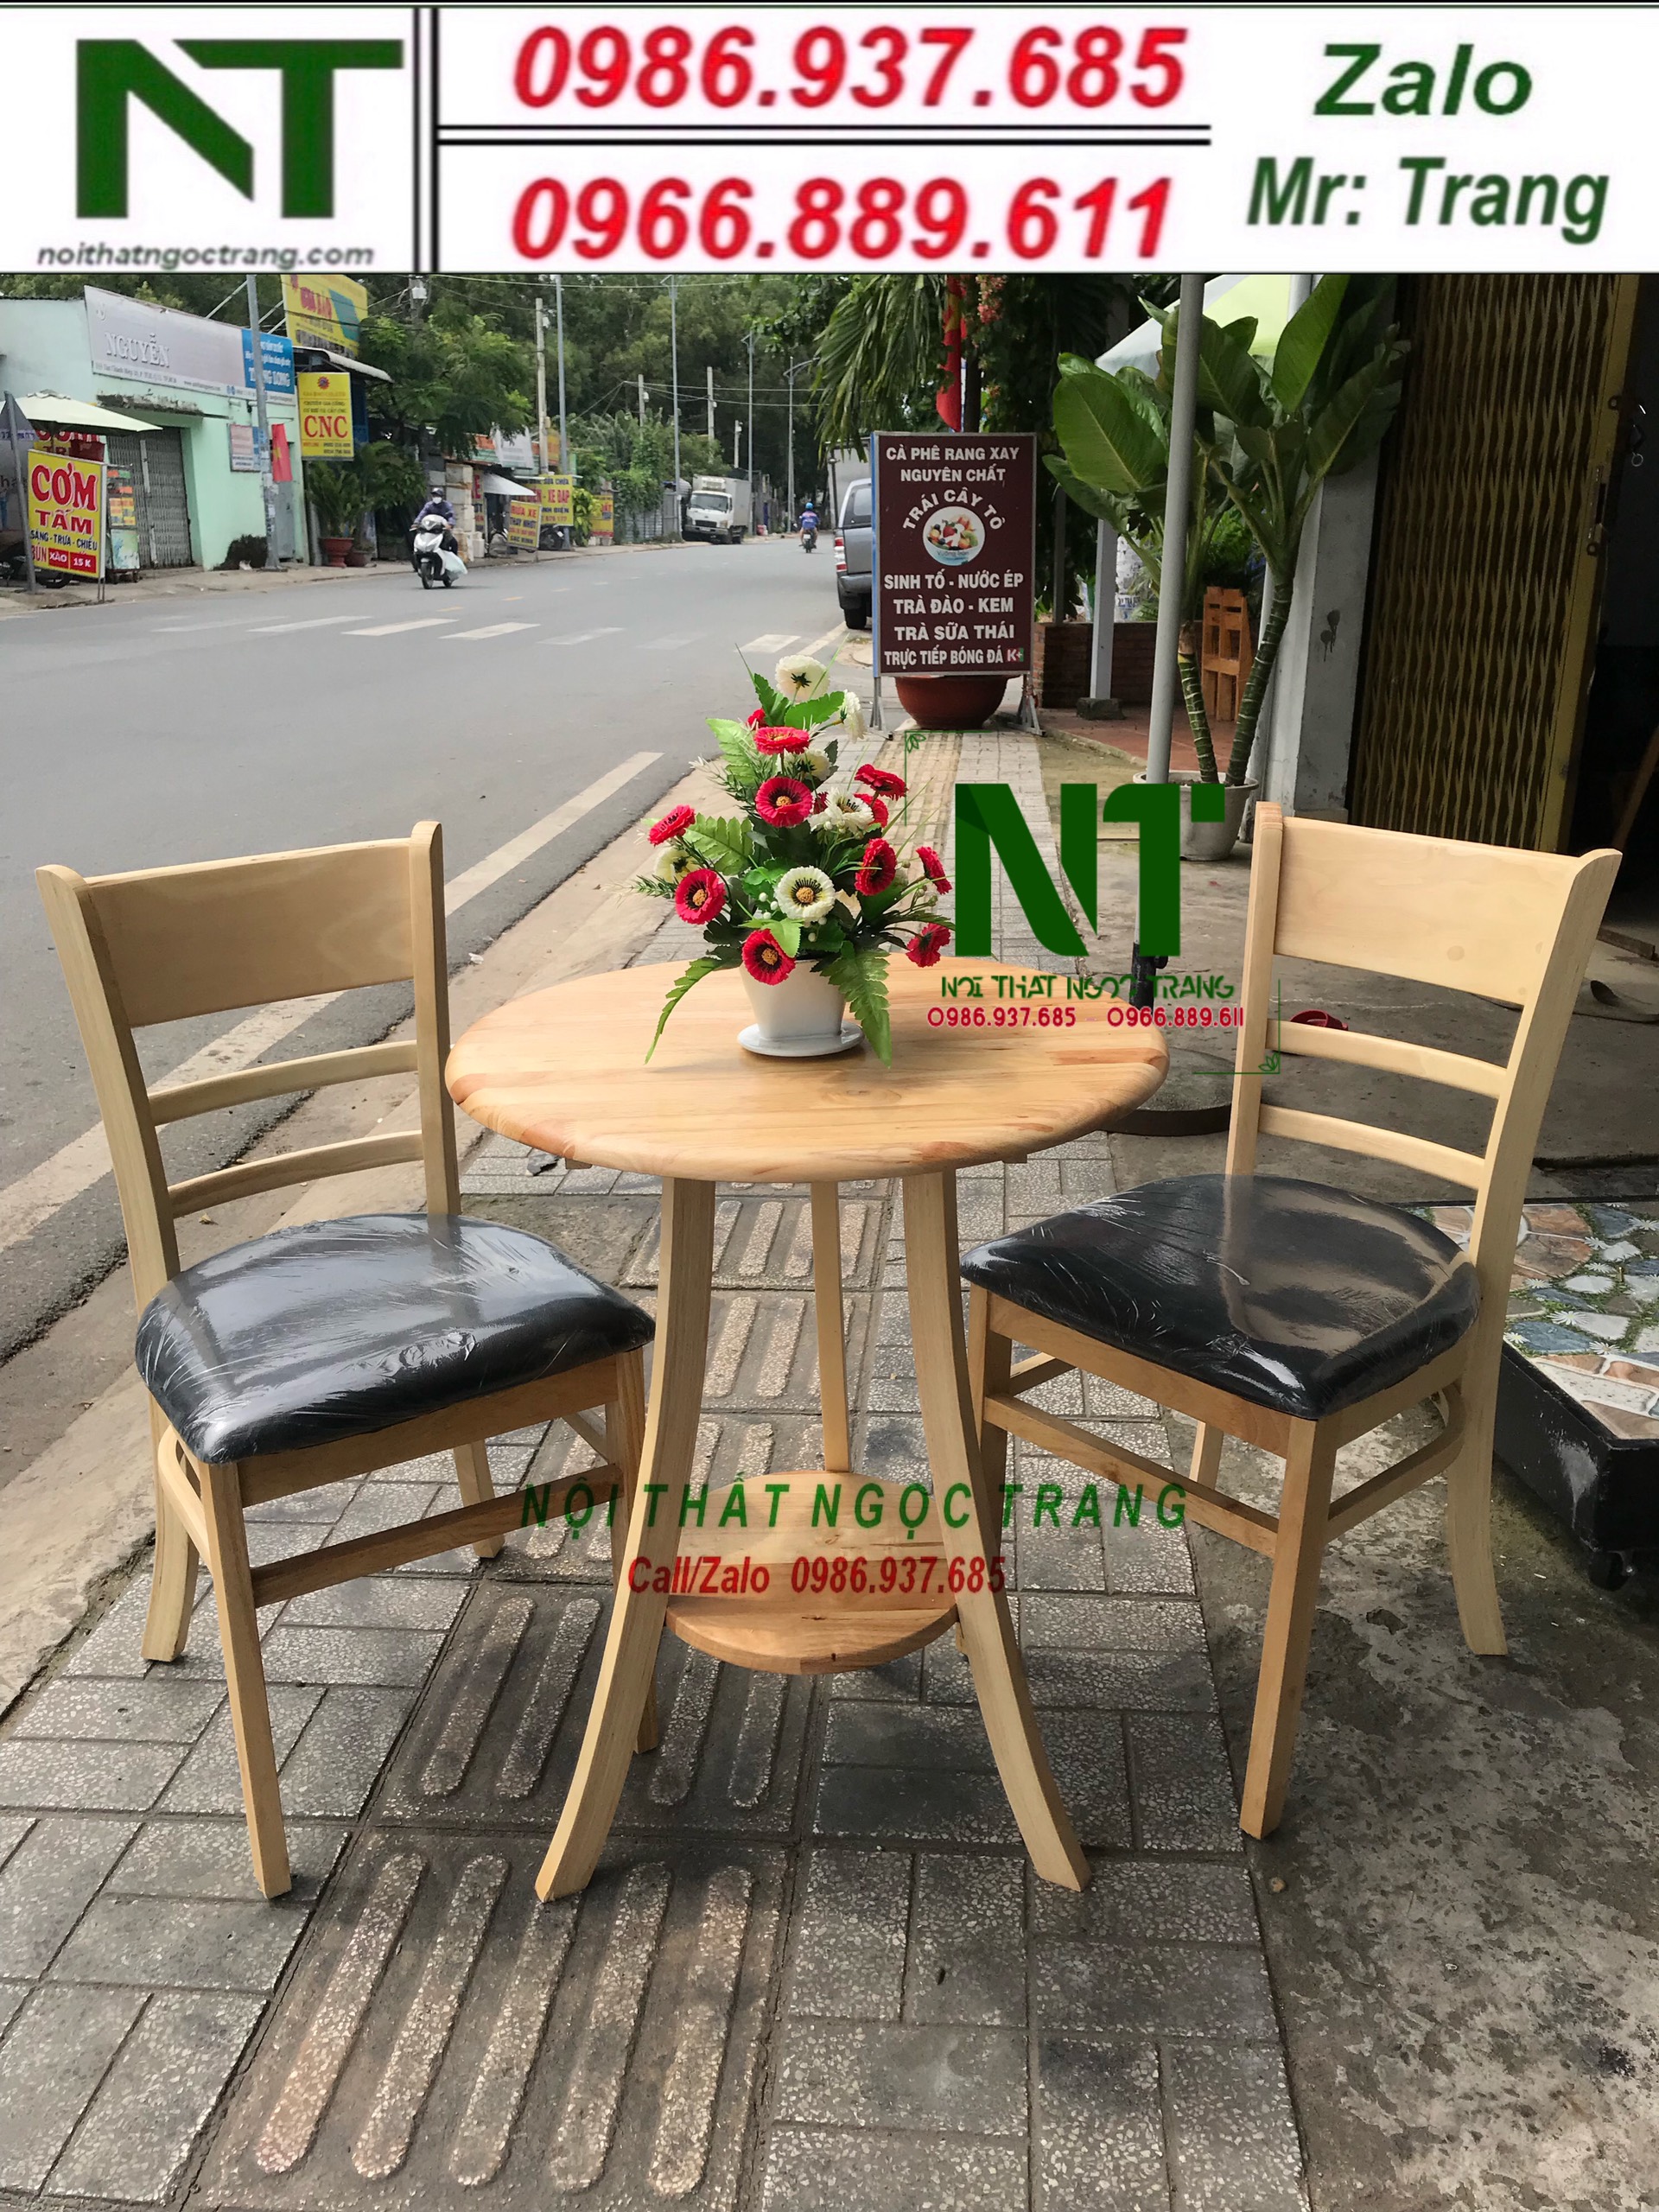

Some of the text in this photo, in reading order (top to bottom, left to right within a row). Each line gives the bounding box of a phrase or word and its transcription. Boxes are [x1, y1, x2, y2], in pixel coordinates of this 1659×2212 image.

[304, 415, 348, 438] CNC
[886, 443, 1020, 461] CÀ PHÊ RANG XAY
[900, 463, 1006, 481] NGUYÊN CHẤT
[31, 461, 98, 512] CƠM
[903, 493, 939, 530] TRÁI
[944, 486, 982, 507] CÂY
[35, 508, 93, 536] TẤM
[884, 574, 921, 589] SINH
[925, 569, 945, 588] TỐ
[958, 569, 1000, 588] NƯỚC
[1004, 569, 1024, 588] ÉP
[893, 594, 926, 614] TRÀ
[930, 594, 964, 614] ĐÀO
[978, 597, 1014, 613] KEM
[894, 620, 1014, 641] TRÀ SỮA THÁI
[884, 648, 917, 670] TRỰC
[919, 644, 947, 664] TIẾP
[950, 645, 984, 664] BÓNG
[986, 645, 1003, 664] ĐÁ
